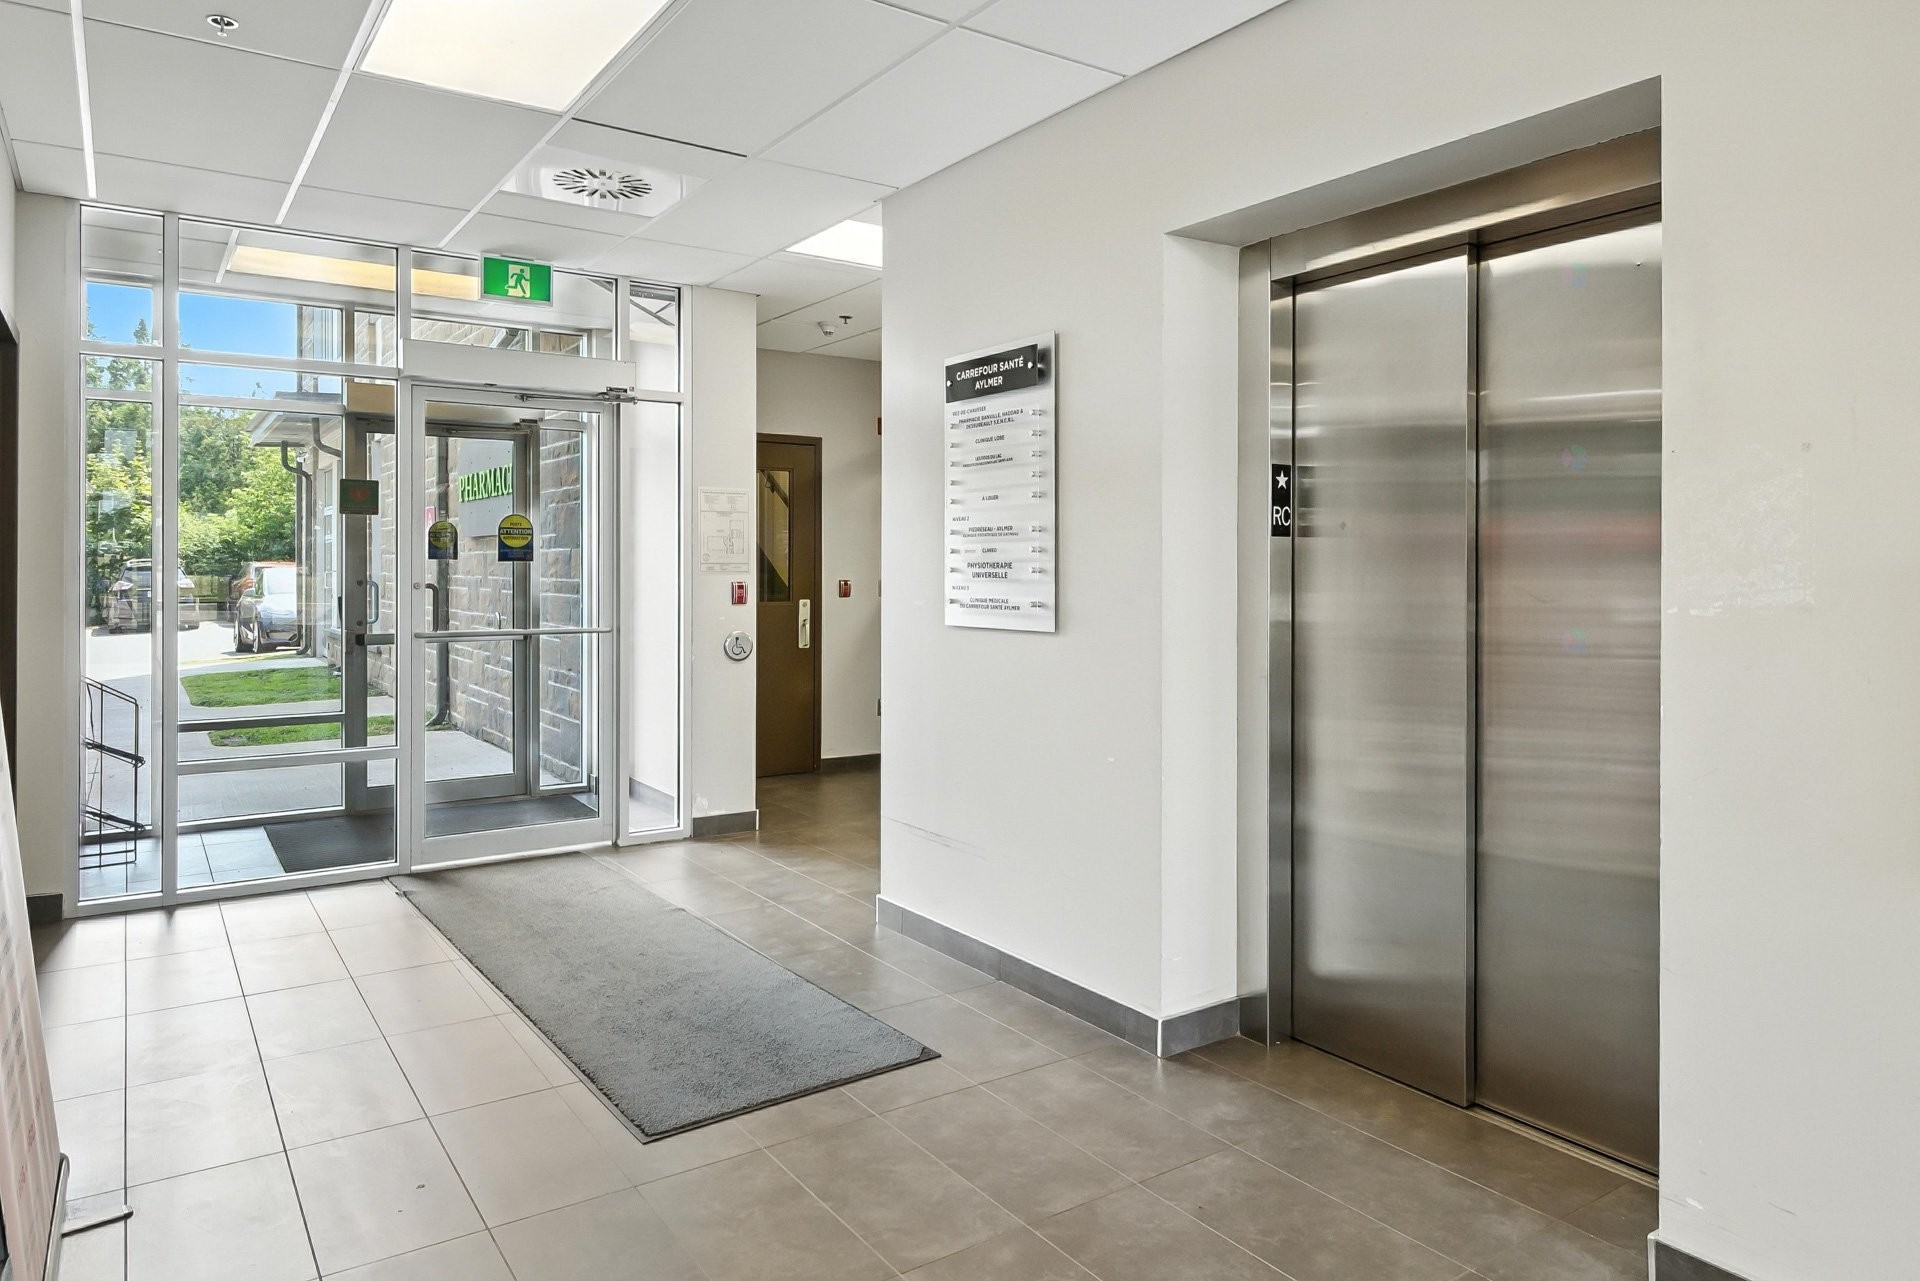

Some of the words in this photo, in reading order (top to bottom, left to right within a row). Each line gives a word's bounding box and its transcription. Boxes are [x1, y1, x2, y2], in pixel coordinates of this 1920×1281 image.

[956, 363, 998, 381] CARREFOUR
[999, 355, 1024, 372] SANTÉ
[974, 375, 1003, 391] AYLMER
[975, 436, 993, 444] CLINIQUE
[1272, 505, 1291, 526] RC
[971, 571, 1008, 579] UNIVERSELLE
